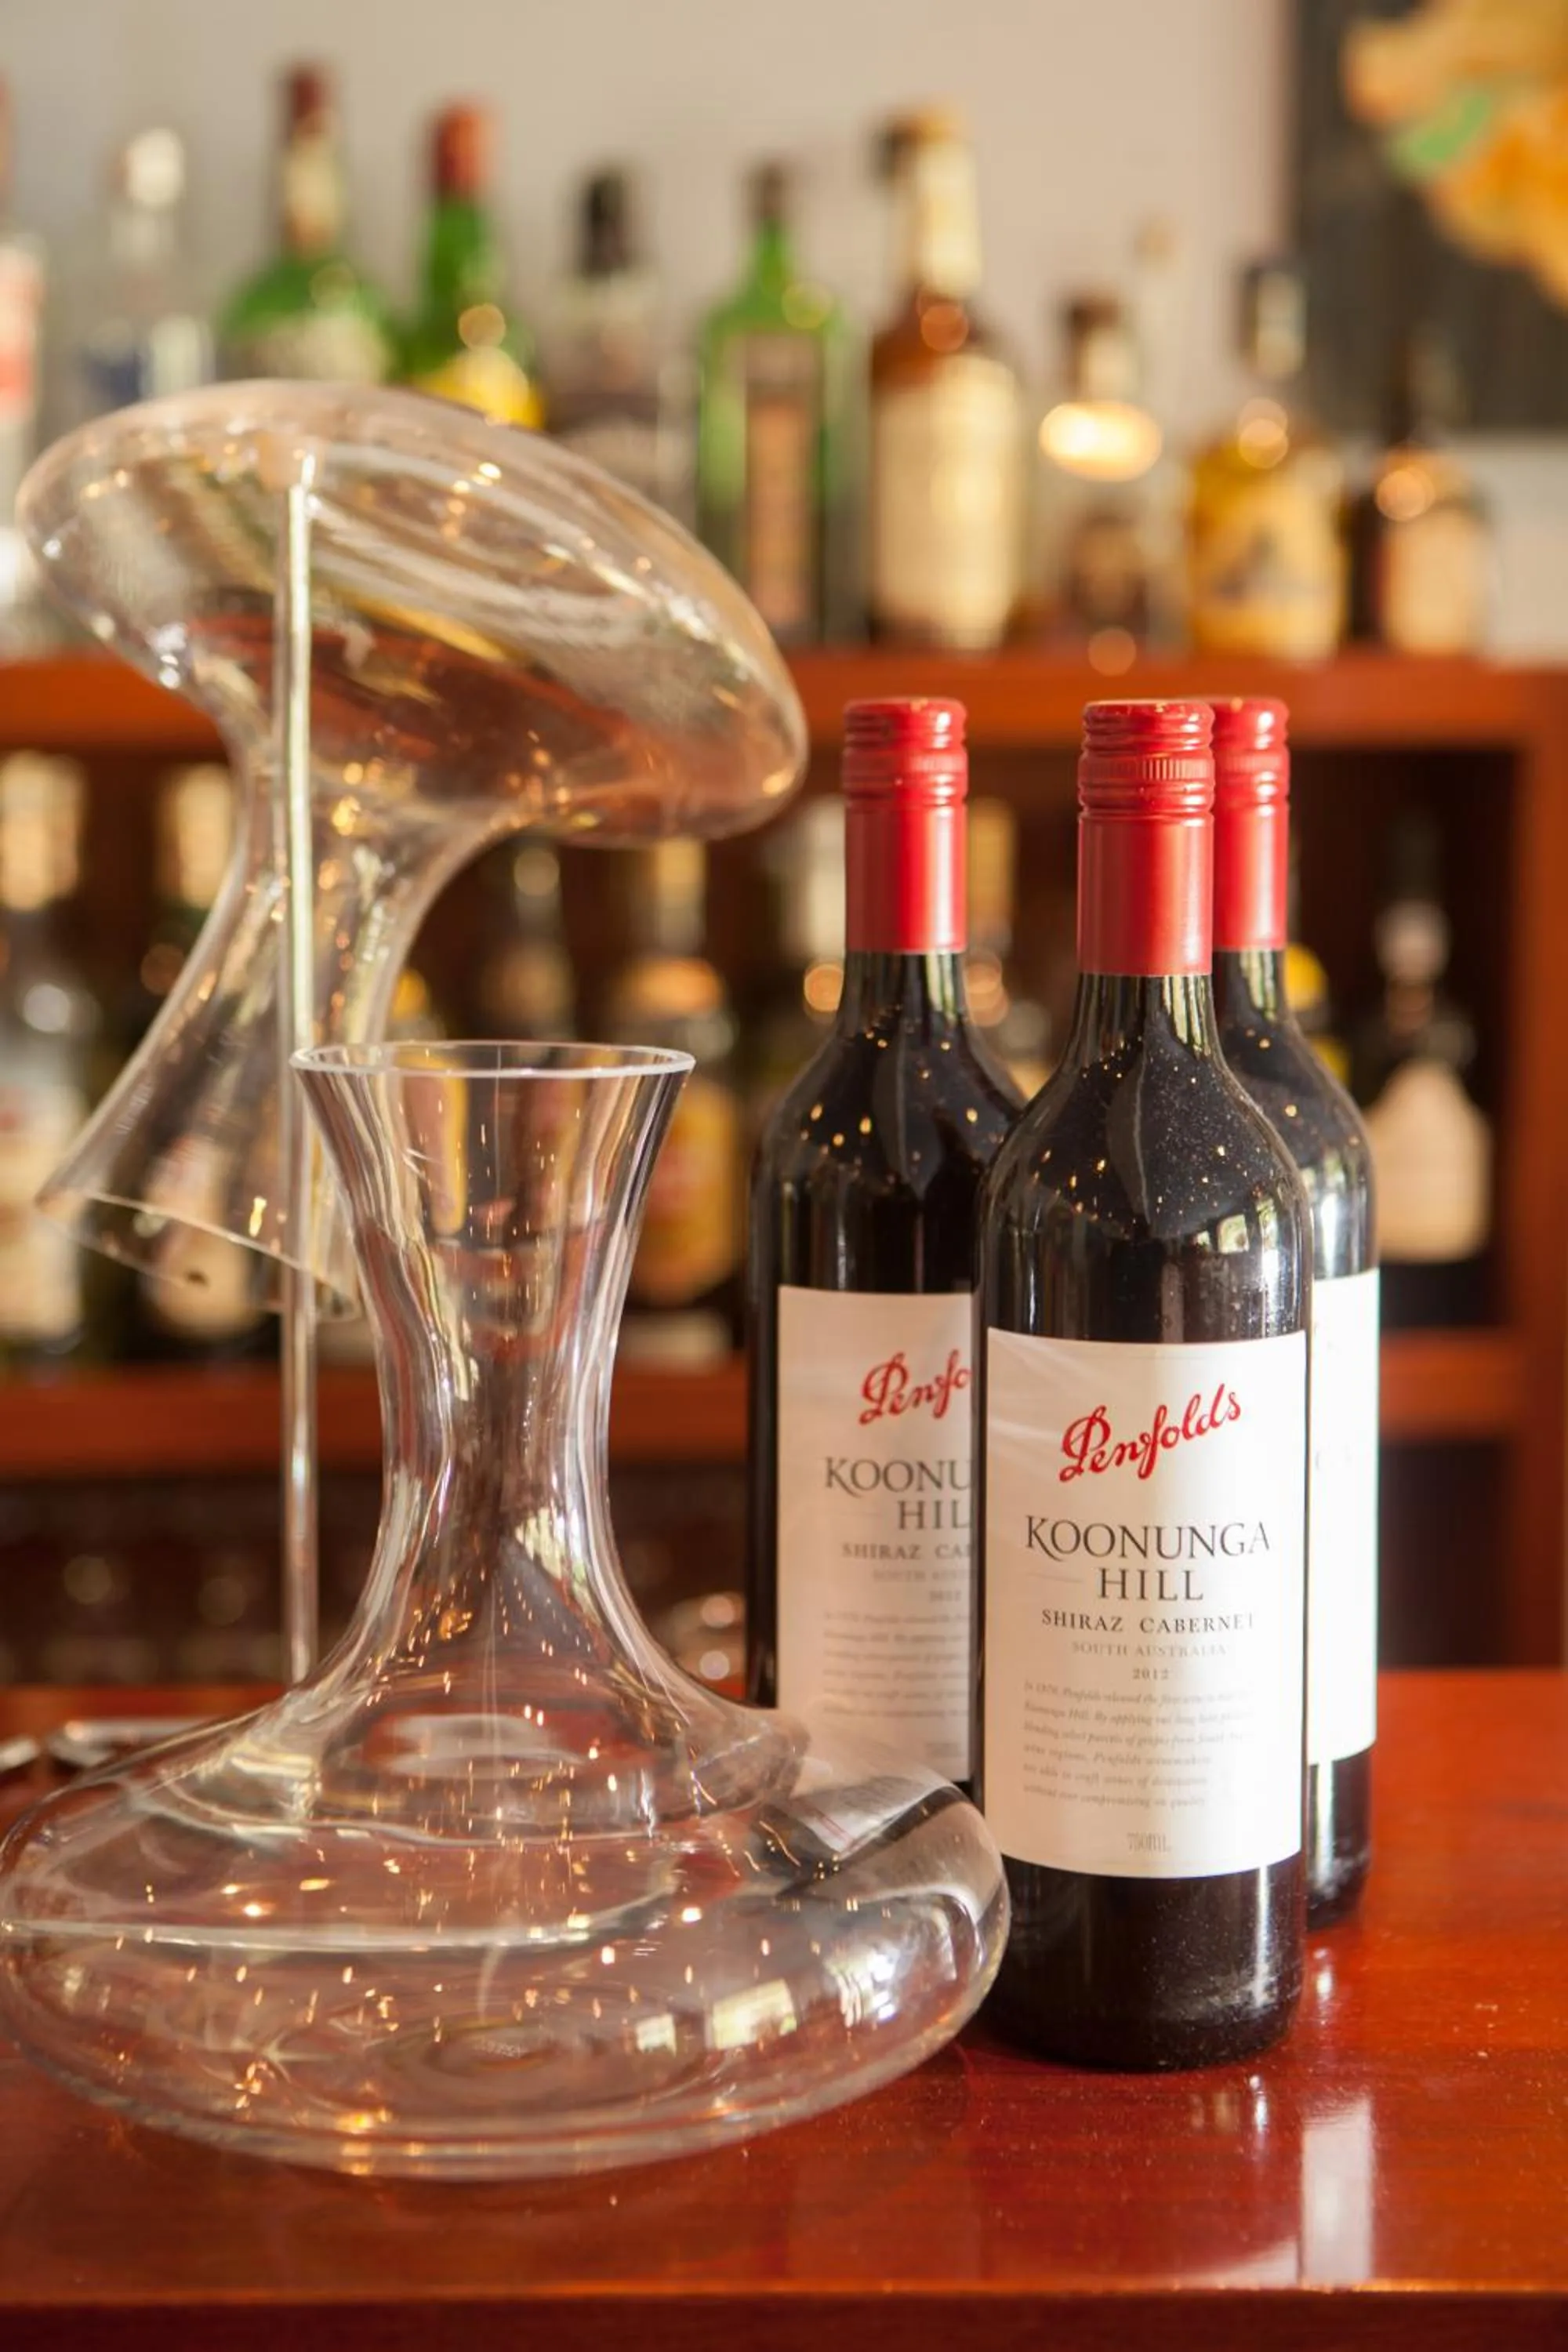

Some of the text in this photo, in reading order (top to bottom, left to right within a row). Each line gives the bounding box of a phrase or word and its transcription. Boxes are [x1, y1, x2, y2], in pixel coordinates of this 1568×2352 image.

[858, 1348, 971, 1425] Penfo
[1059, 1383, 1242, 1482] Penfolds
[824, 1456, 971, 1499] KOONU
[898, 1500, 971, 1530] HIL
[841, 1541, 923, 1561] SHIRAZ
[1025, 1515, 1271, 1563] KOONUNGA
[1098, 1567, 1205, 1602] HILL
[1041, 1609, 1124, 1633] SHIRAZ
[1131, 1668, 1171, 1681] 2012
